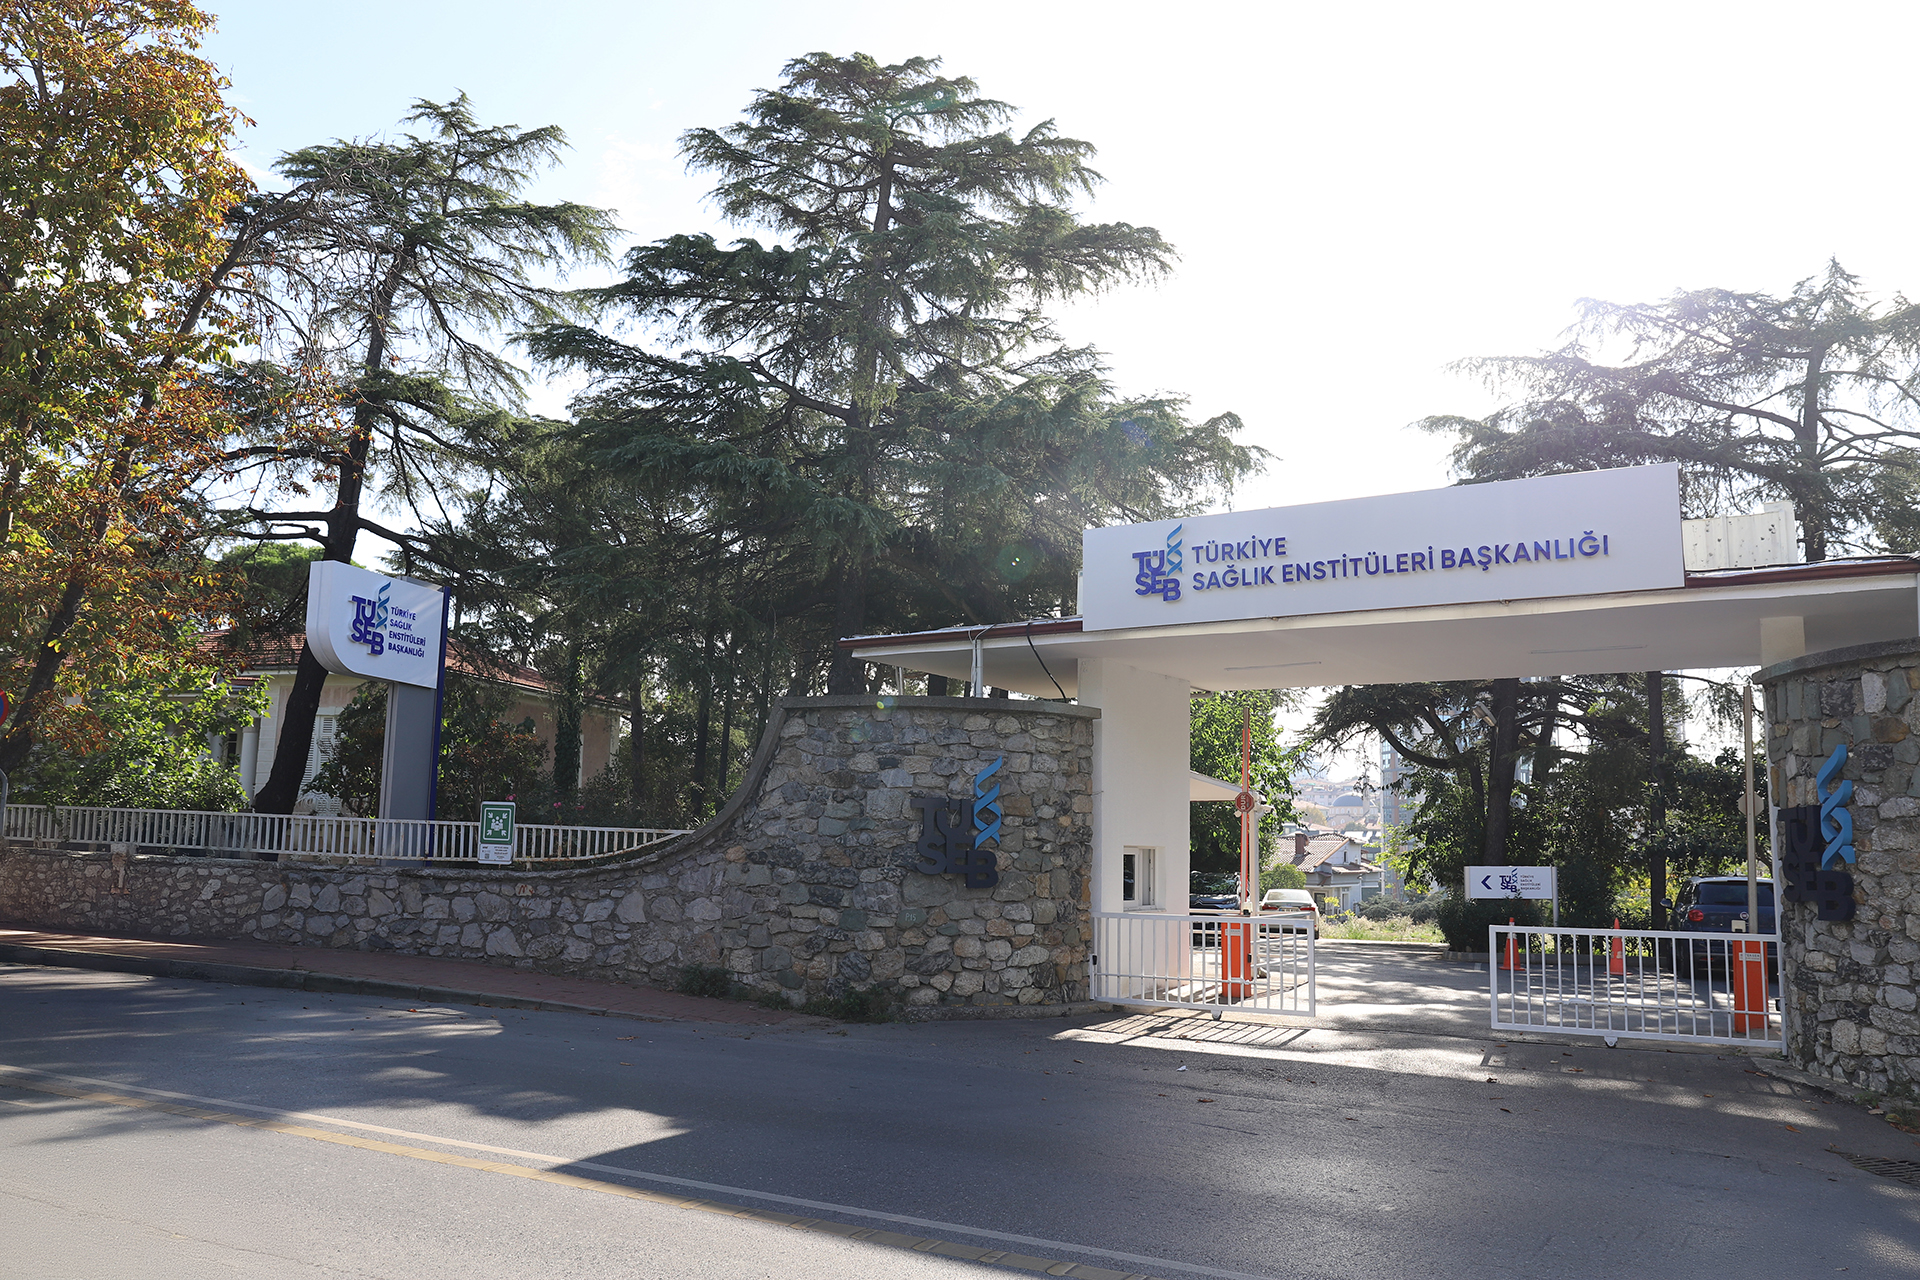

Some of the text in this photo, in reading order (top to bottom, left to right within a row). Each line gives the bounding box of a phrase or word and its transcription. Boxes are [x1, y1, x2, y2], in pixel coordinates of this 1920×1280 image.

[1191, 535, 1287, 564] TÜRKİYE
[1192, 530, 1609, 591] SAĞLIK ENSTİTÜLERİ BAŞKANLIĞI
[391, 606, 416, 620] TÜRKİYE
[390, 619, 412, 631] SAĞLIK
[389, 631, 426, 646] ENSTİTÜLERİ
[388, 642, 425, 658] BAŞKANLIĞI
